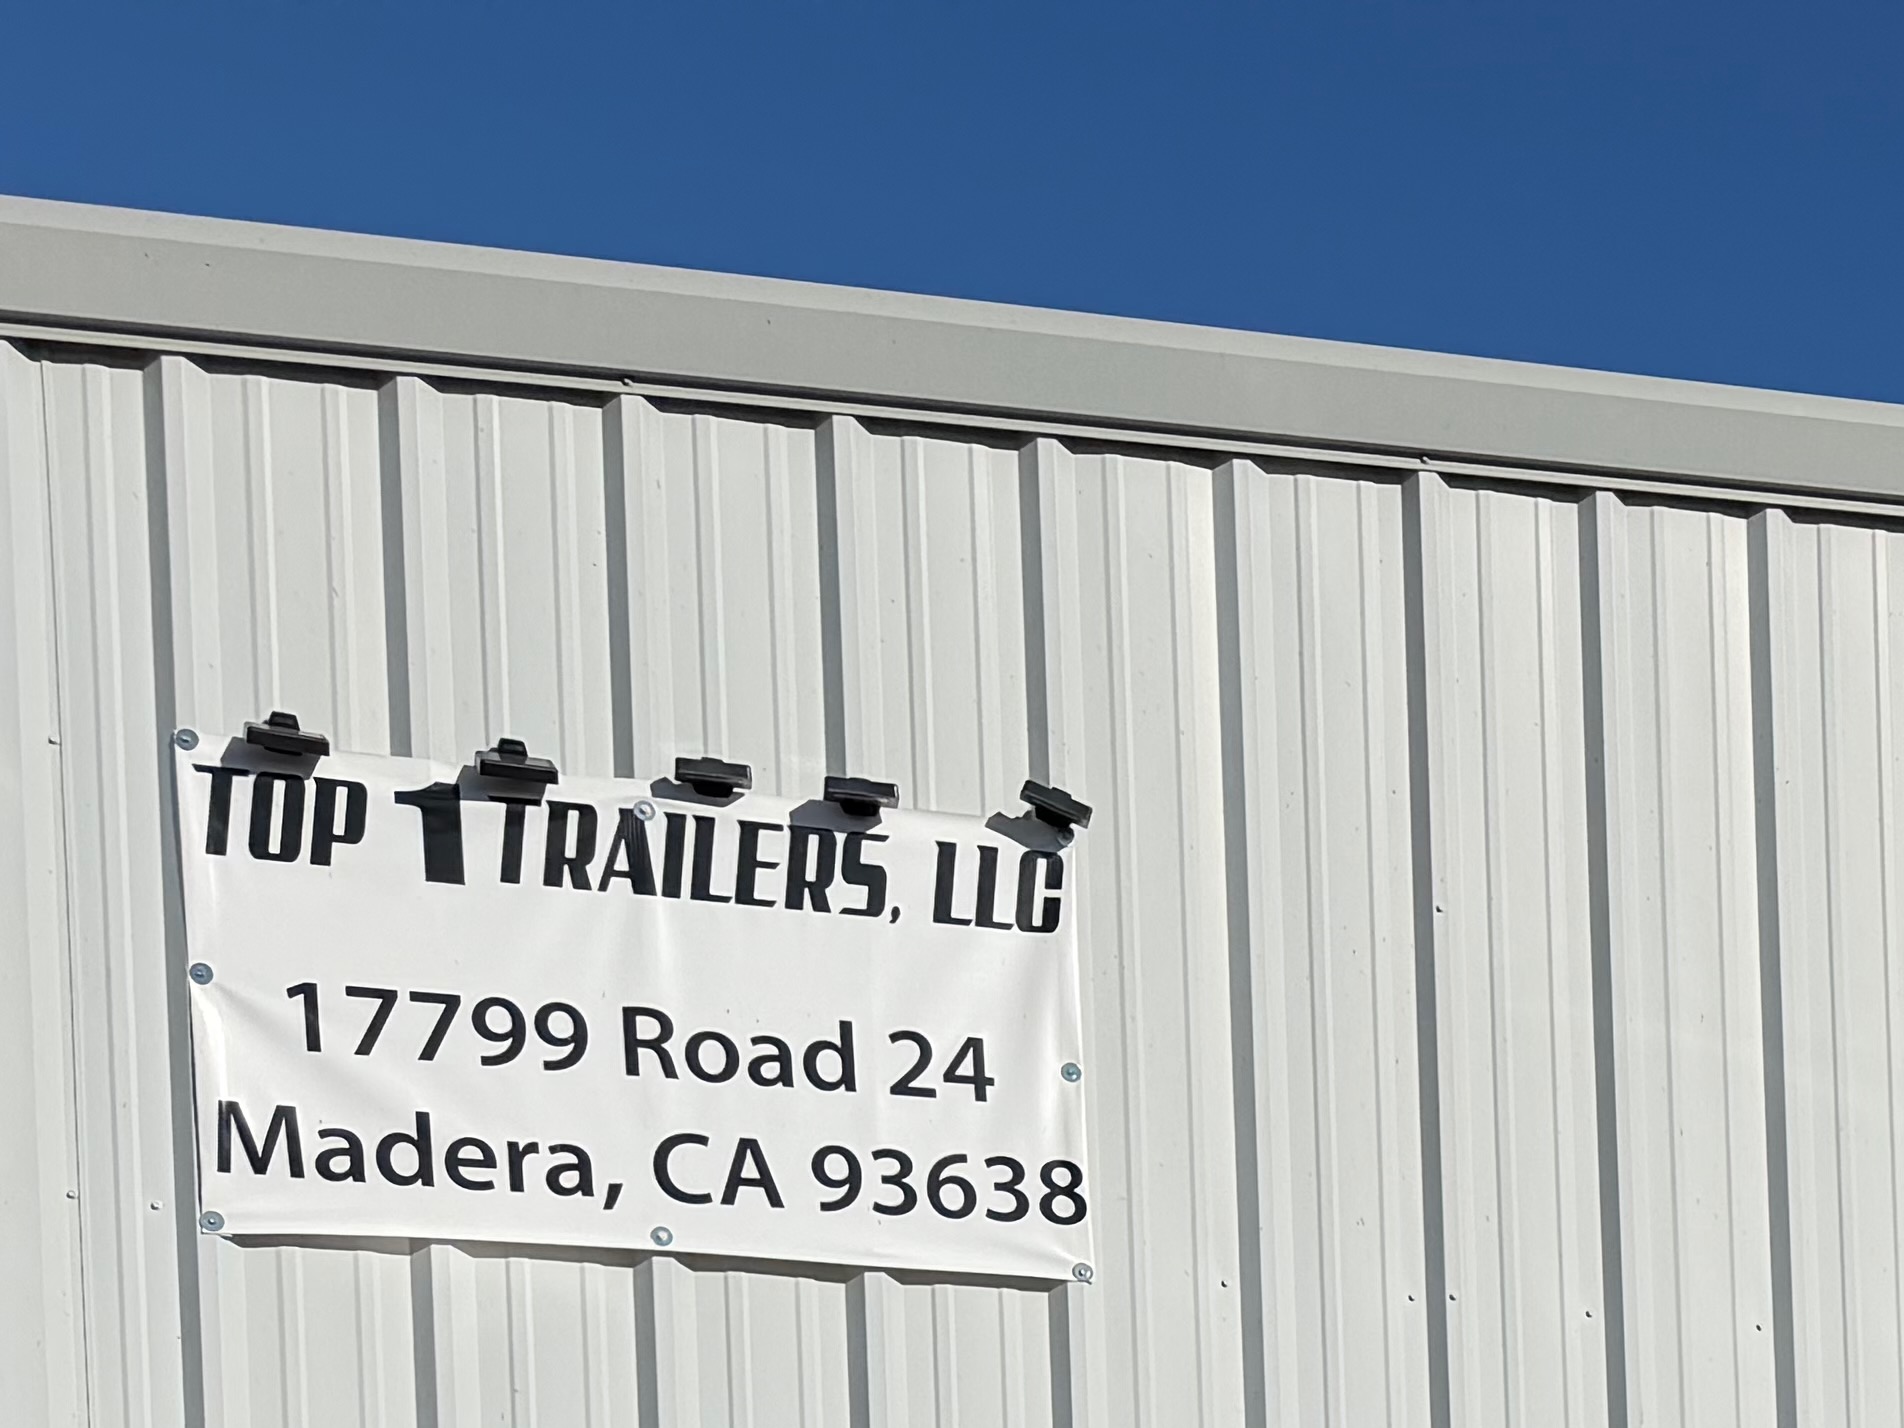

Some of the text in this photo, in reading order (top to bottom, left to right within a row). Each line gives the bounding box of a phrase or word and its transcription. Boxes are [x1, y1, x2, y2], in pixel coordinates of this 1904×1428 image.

[193, 763, 1064, 934] TOP 1 TRAILERS, LLC
[286, 983, 994, 1103] 17799 Road 24
[216, 1100, 1088, 1227] Madera, CA 93638
